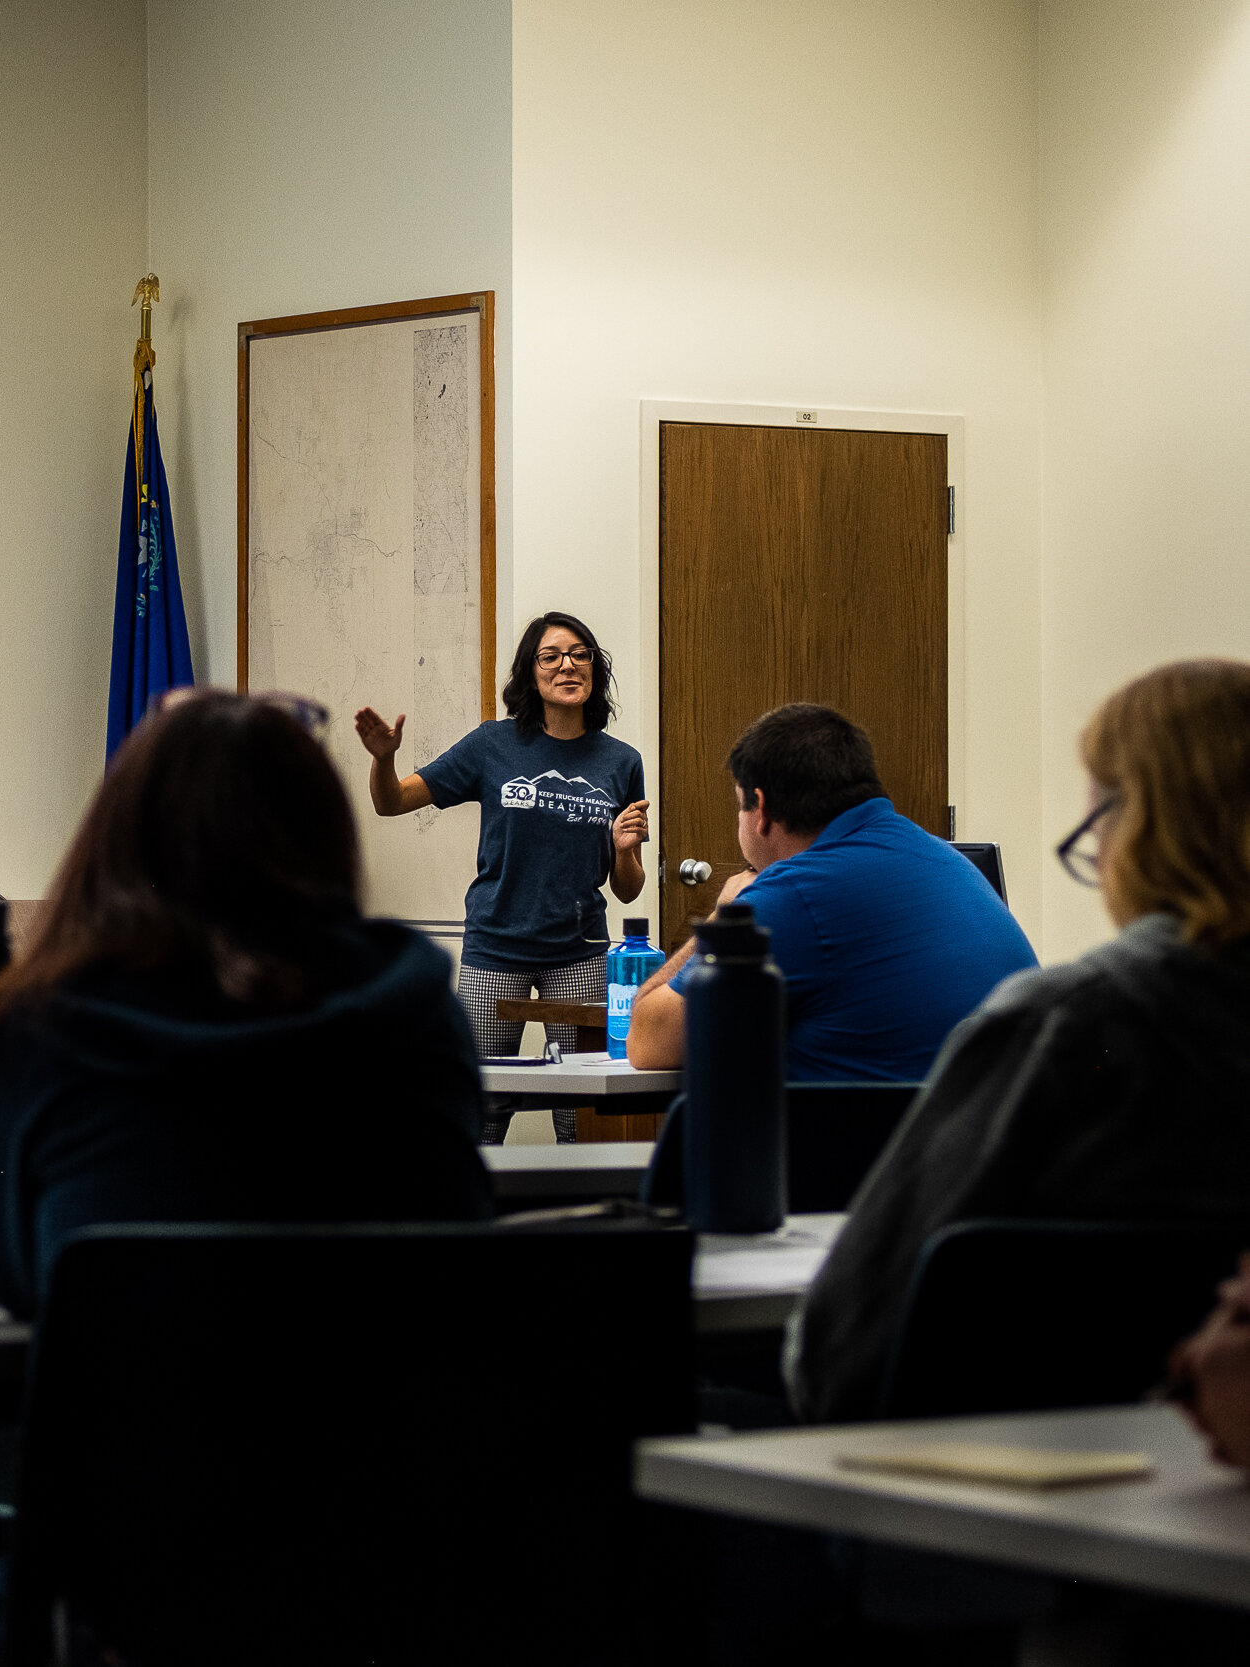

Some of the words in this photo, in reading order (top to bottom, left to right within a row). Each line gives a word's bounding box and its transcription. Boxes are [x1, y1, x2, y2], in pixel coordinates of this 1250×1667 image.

[505, 785, 531, 801] 30
[538, 790, 554, 798] KEEP
[555, 793, 584, 803] TRUCKEE
